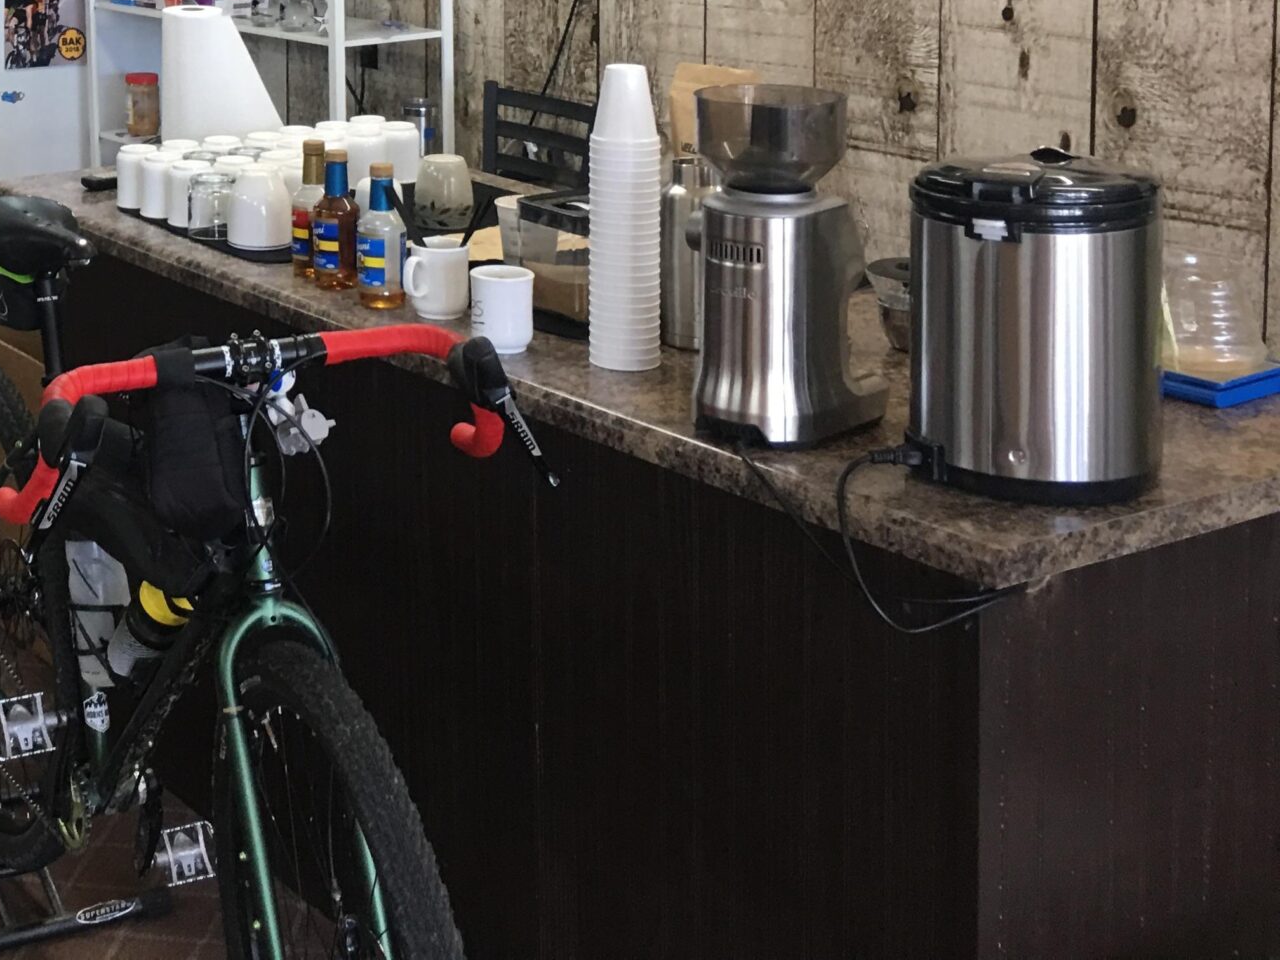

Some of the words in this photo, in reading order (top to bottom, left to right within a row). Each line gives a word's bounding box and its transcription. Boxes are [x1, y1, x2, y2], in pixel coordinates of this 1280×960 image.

[61, 37, 82, 46] BAK
[509, 411, 536, 452] SRAM
[47, 478, 75, 523] SRAM
